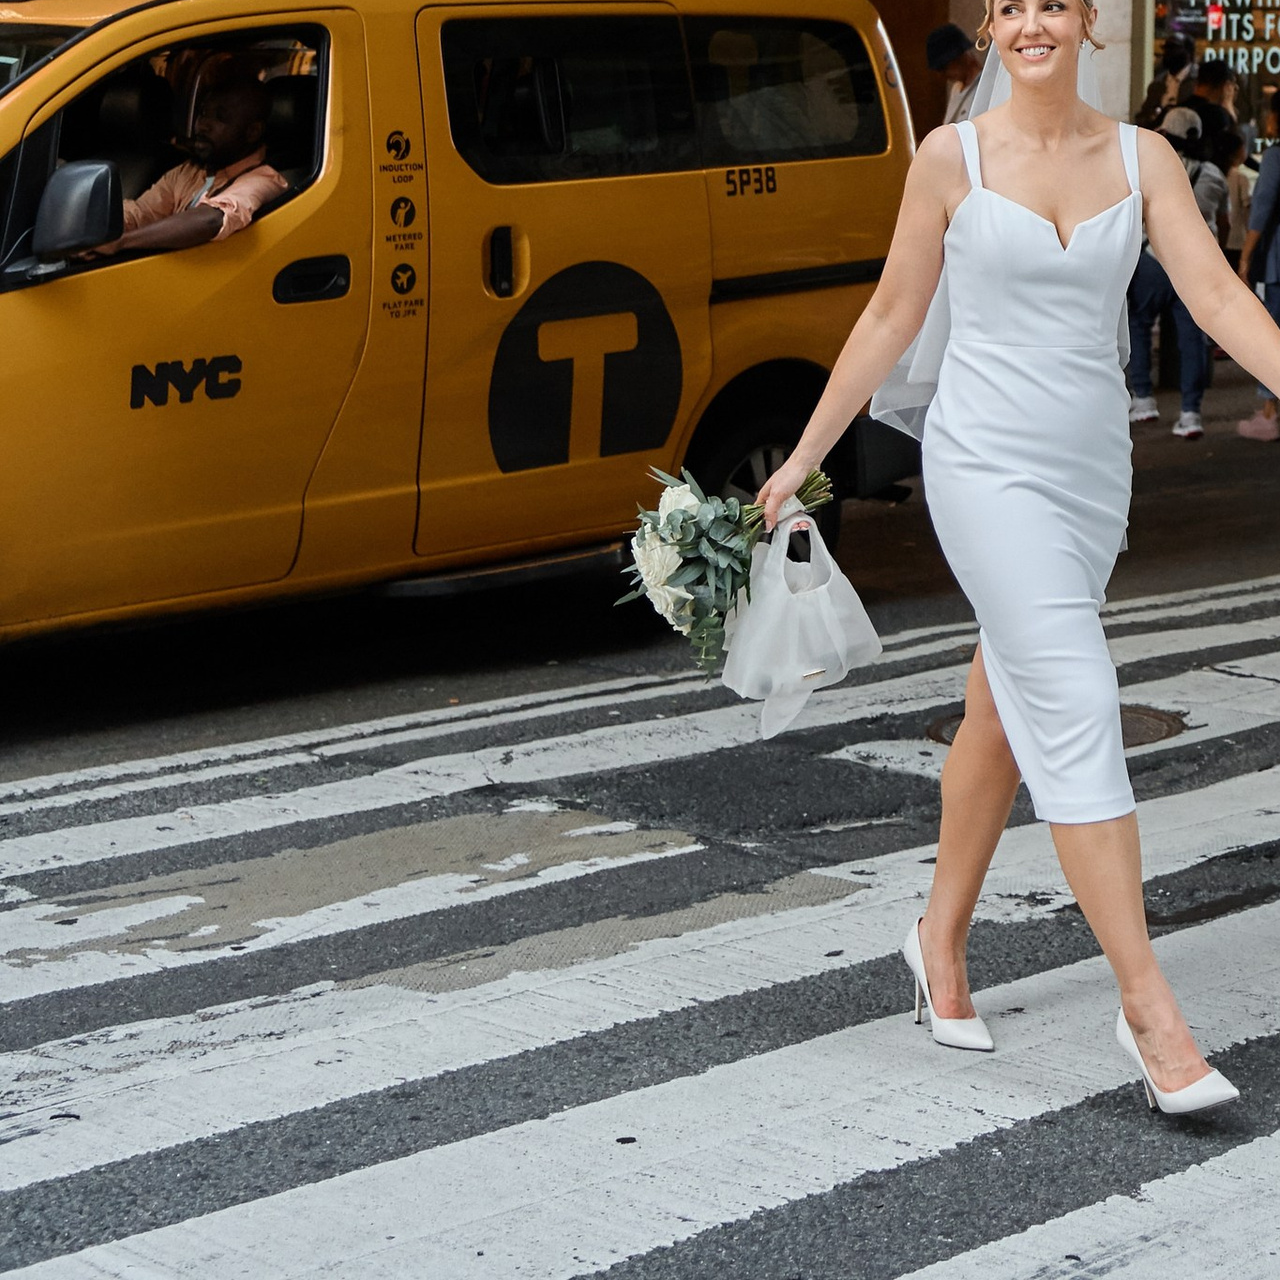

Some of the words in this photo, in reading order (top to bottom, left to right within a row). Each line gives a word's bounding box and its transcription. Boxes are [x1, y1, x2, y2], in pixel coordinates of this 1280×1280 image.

[379, 163, 424, 173] INDUCTION
[392, 175, 414, 184] LOOP
[726, 167, 777, 197] 5P38
[386, 232, 424, 243] METERED
[394, 242, 415, 251] FARE
[382, 301, 403, 311] FLAT
[130, 355, 243, 410] NYC
